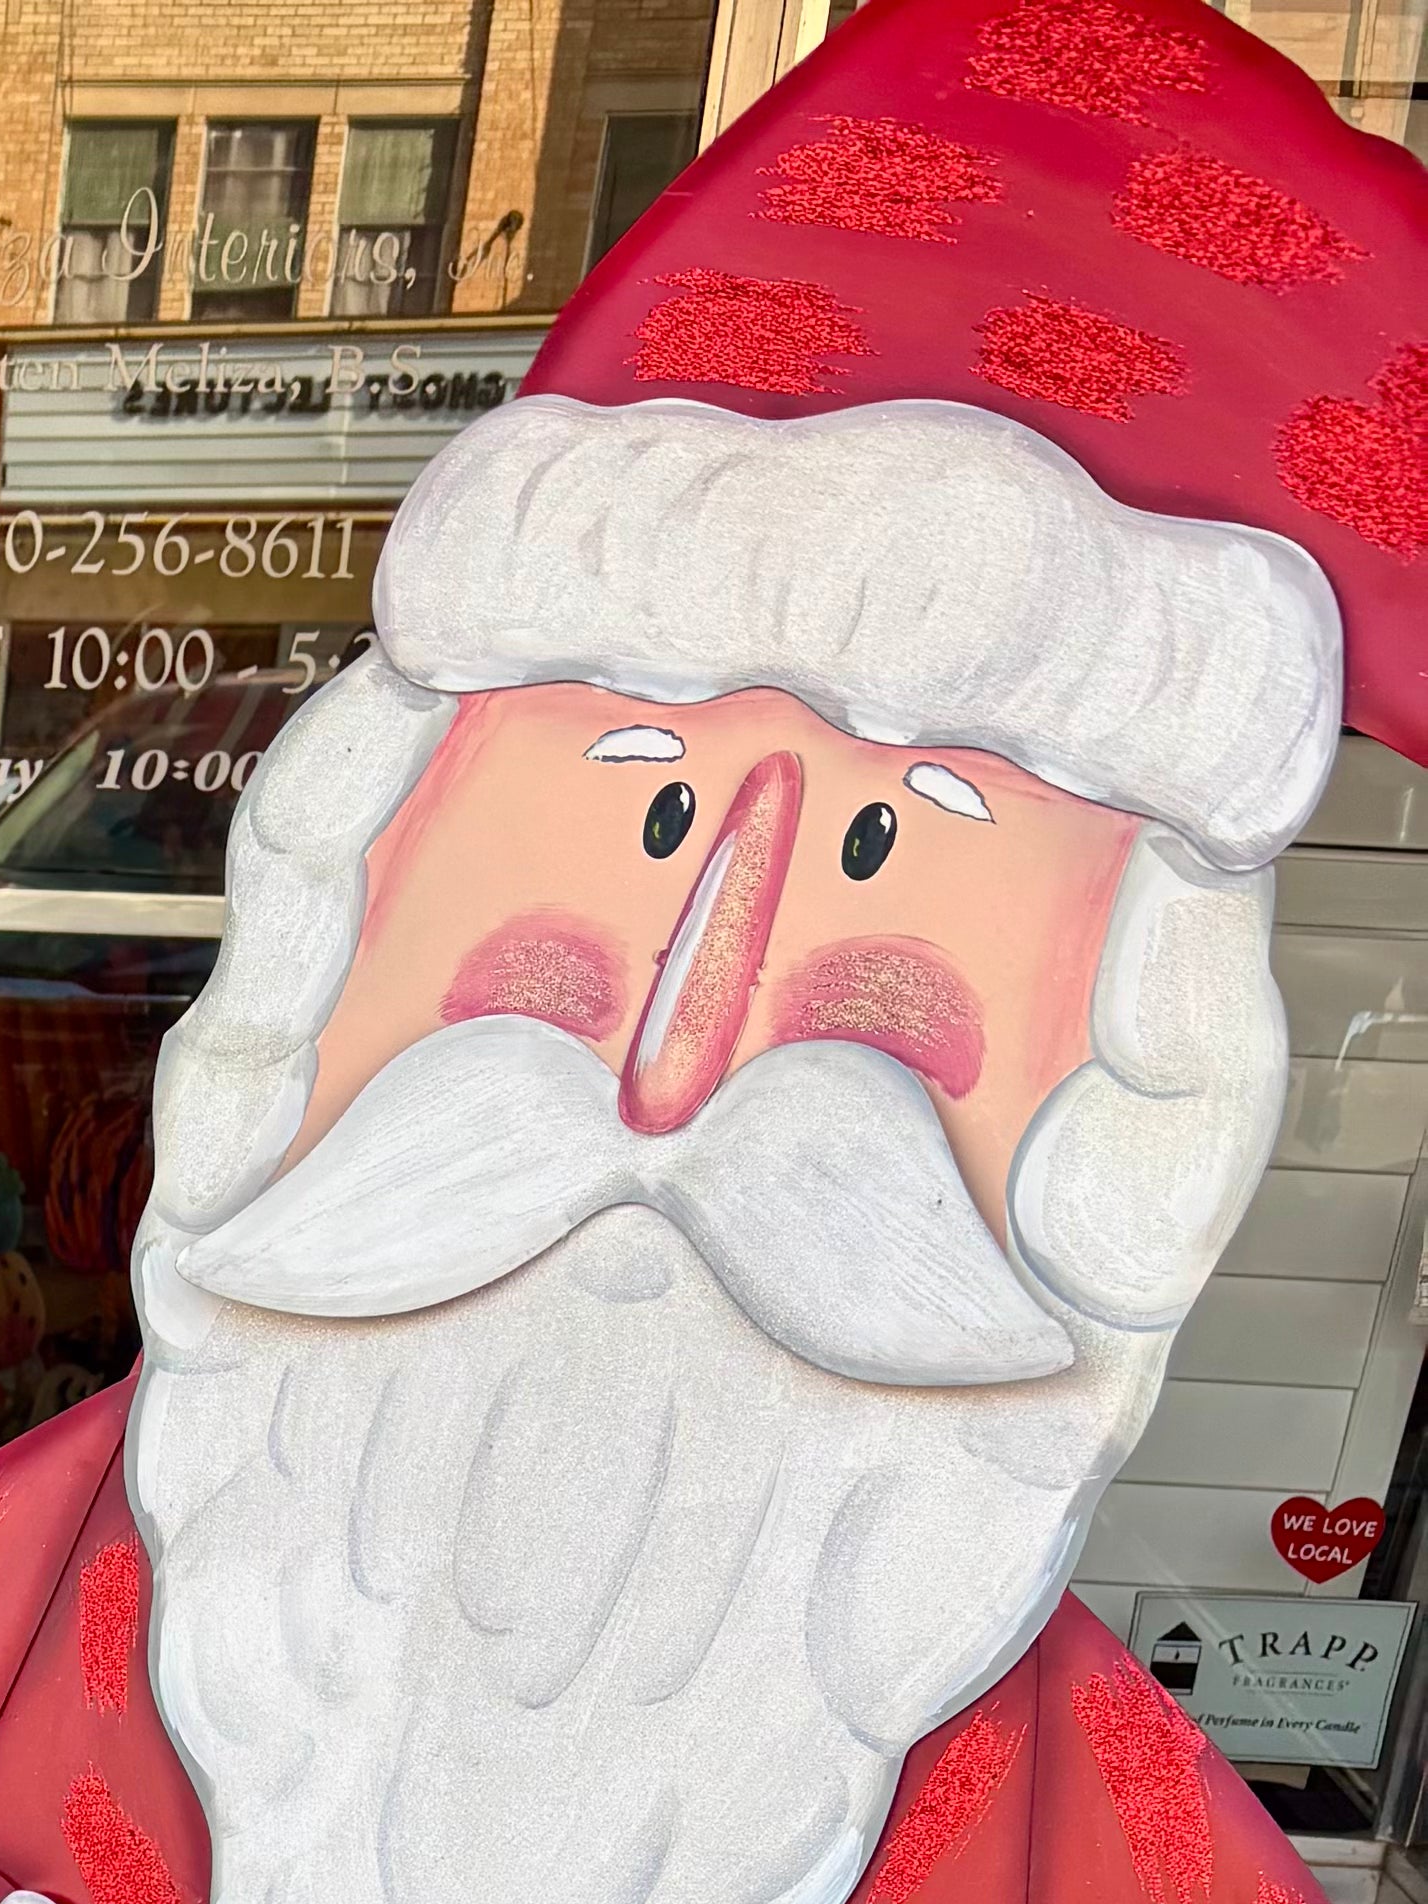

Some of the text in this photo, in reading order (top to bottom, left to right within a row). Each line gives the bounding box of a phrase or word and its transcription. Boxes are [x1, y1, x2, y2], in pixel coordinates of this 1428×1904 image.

[104, 341, 304, 403] Meliza,
[326, 343, 437, 396] B.S.
[43, 626, 215, 693] 10:00
[1282, 1512, 1378, 1539] WE LOVE
[1287, 1543, 1353, 1565] LOCAL
[1218, 1630, 1379, 1671] TRAPP
[1204, 1714, 1259, 1729] Perfume
[1260, 1715, 1275, 1728] in
[1277, 1716, 1313, 1732] Every
[1314, 1718, 1361, 1734] Candle
